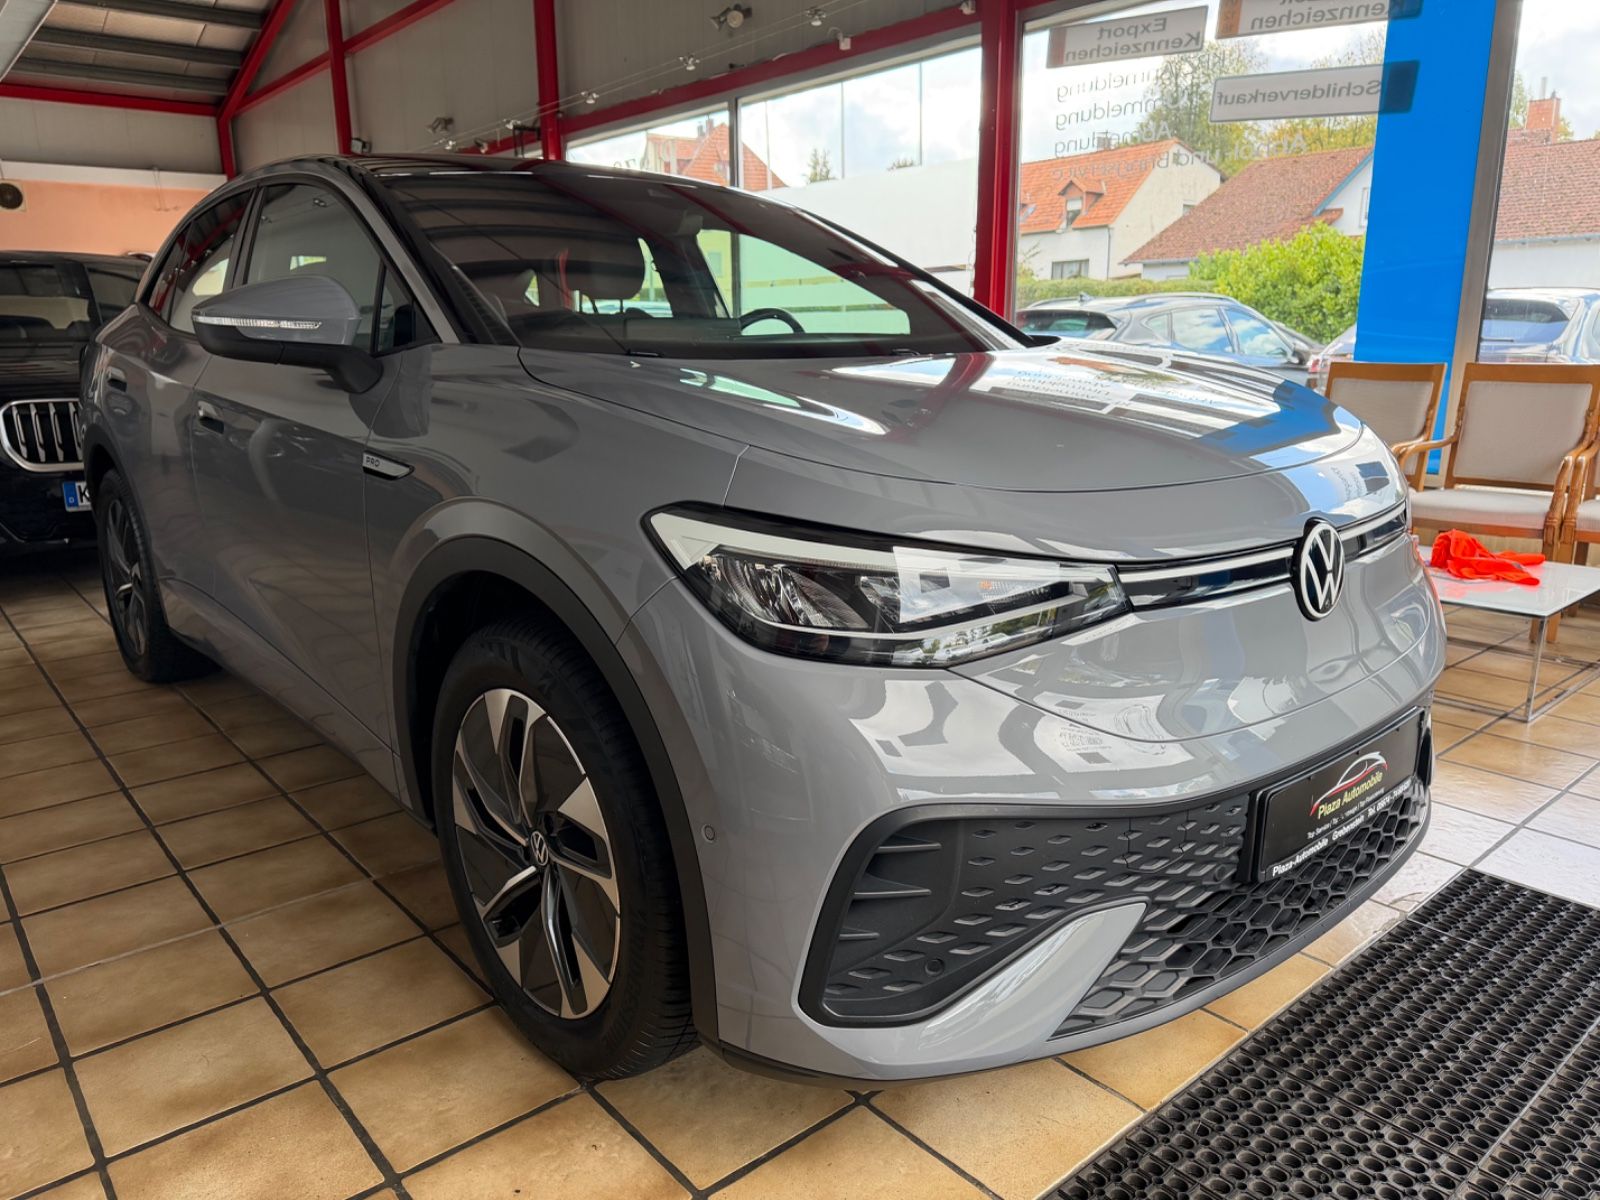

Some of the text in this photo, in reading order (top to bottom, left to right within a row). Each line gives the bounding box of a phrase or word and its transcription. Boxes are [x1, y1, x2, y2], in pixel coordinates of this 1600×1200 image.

[365, 455, 380, 468] PRO
[1317, 798, 1341, 819] Plaza
[1341, 770, 1383, 806] Automobile
[1271, 838, 1329, 877] Plaza-Automobile
